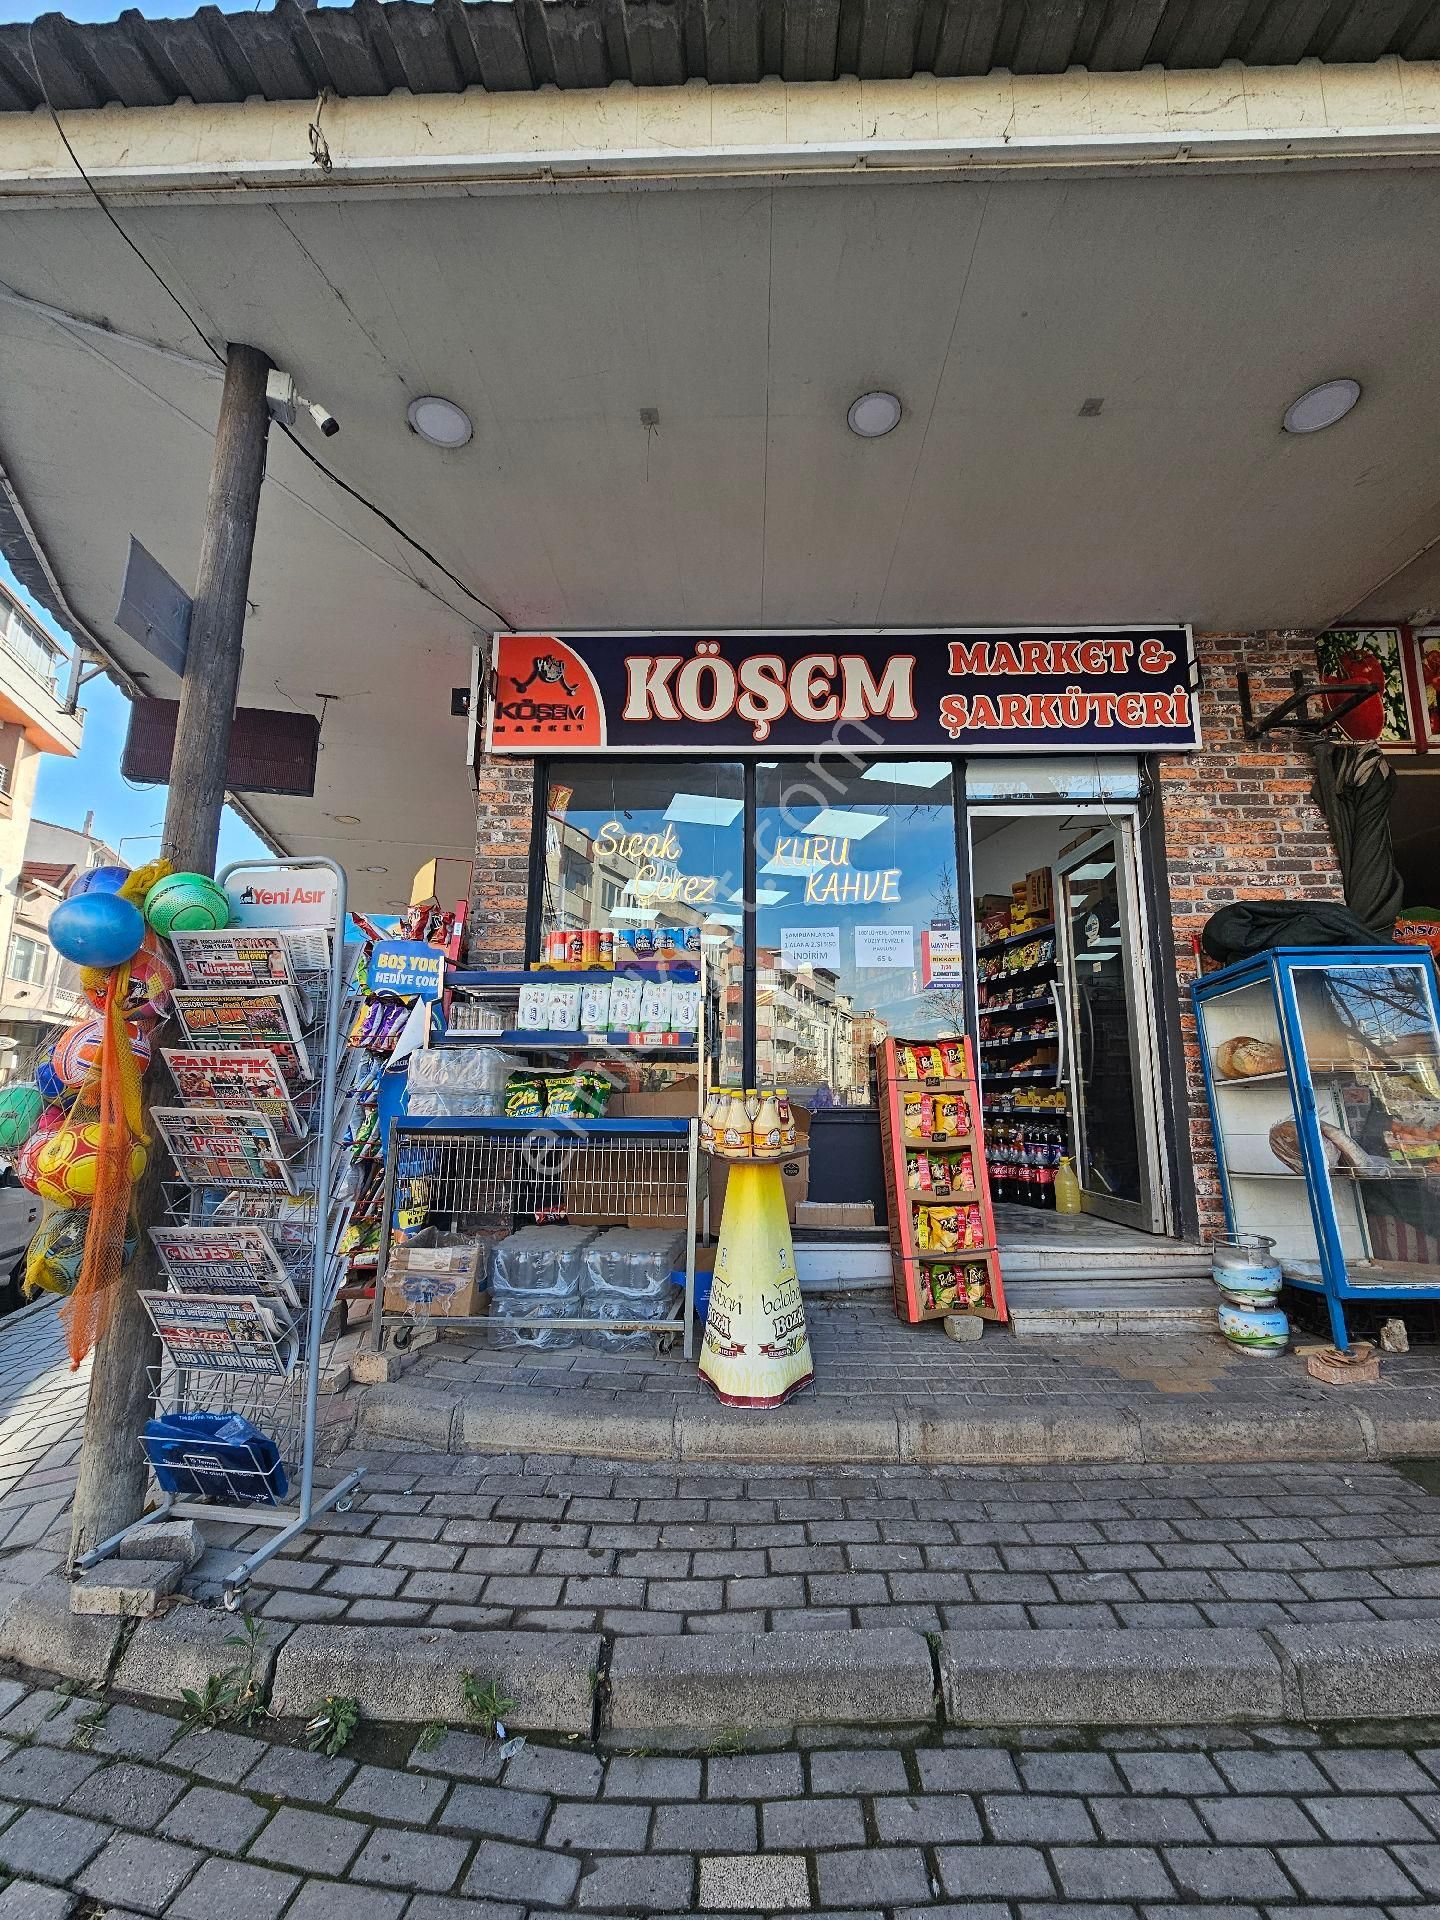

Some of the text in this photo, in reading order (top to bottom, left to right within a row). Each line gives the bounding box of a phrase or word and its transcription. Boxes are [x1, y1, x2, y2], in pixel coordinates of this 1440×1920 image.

[948, 640, 1174, 676] MARKET &
[622, 640, 918, 741] KÖŞEM
[939, 684, 1192, 740] ŞARKÜTERİ
[774, 836, 850, 867] KURU
[253, 887, 326, 905] Yeni Asır
[804, 869, 901, 903] KAHVE
[377, 953, 407, 973] BOŞ
[793, 950, 829, 960] İNDİRİM
[374, 971, 414, 985] HEDİYE
